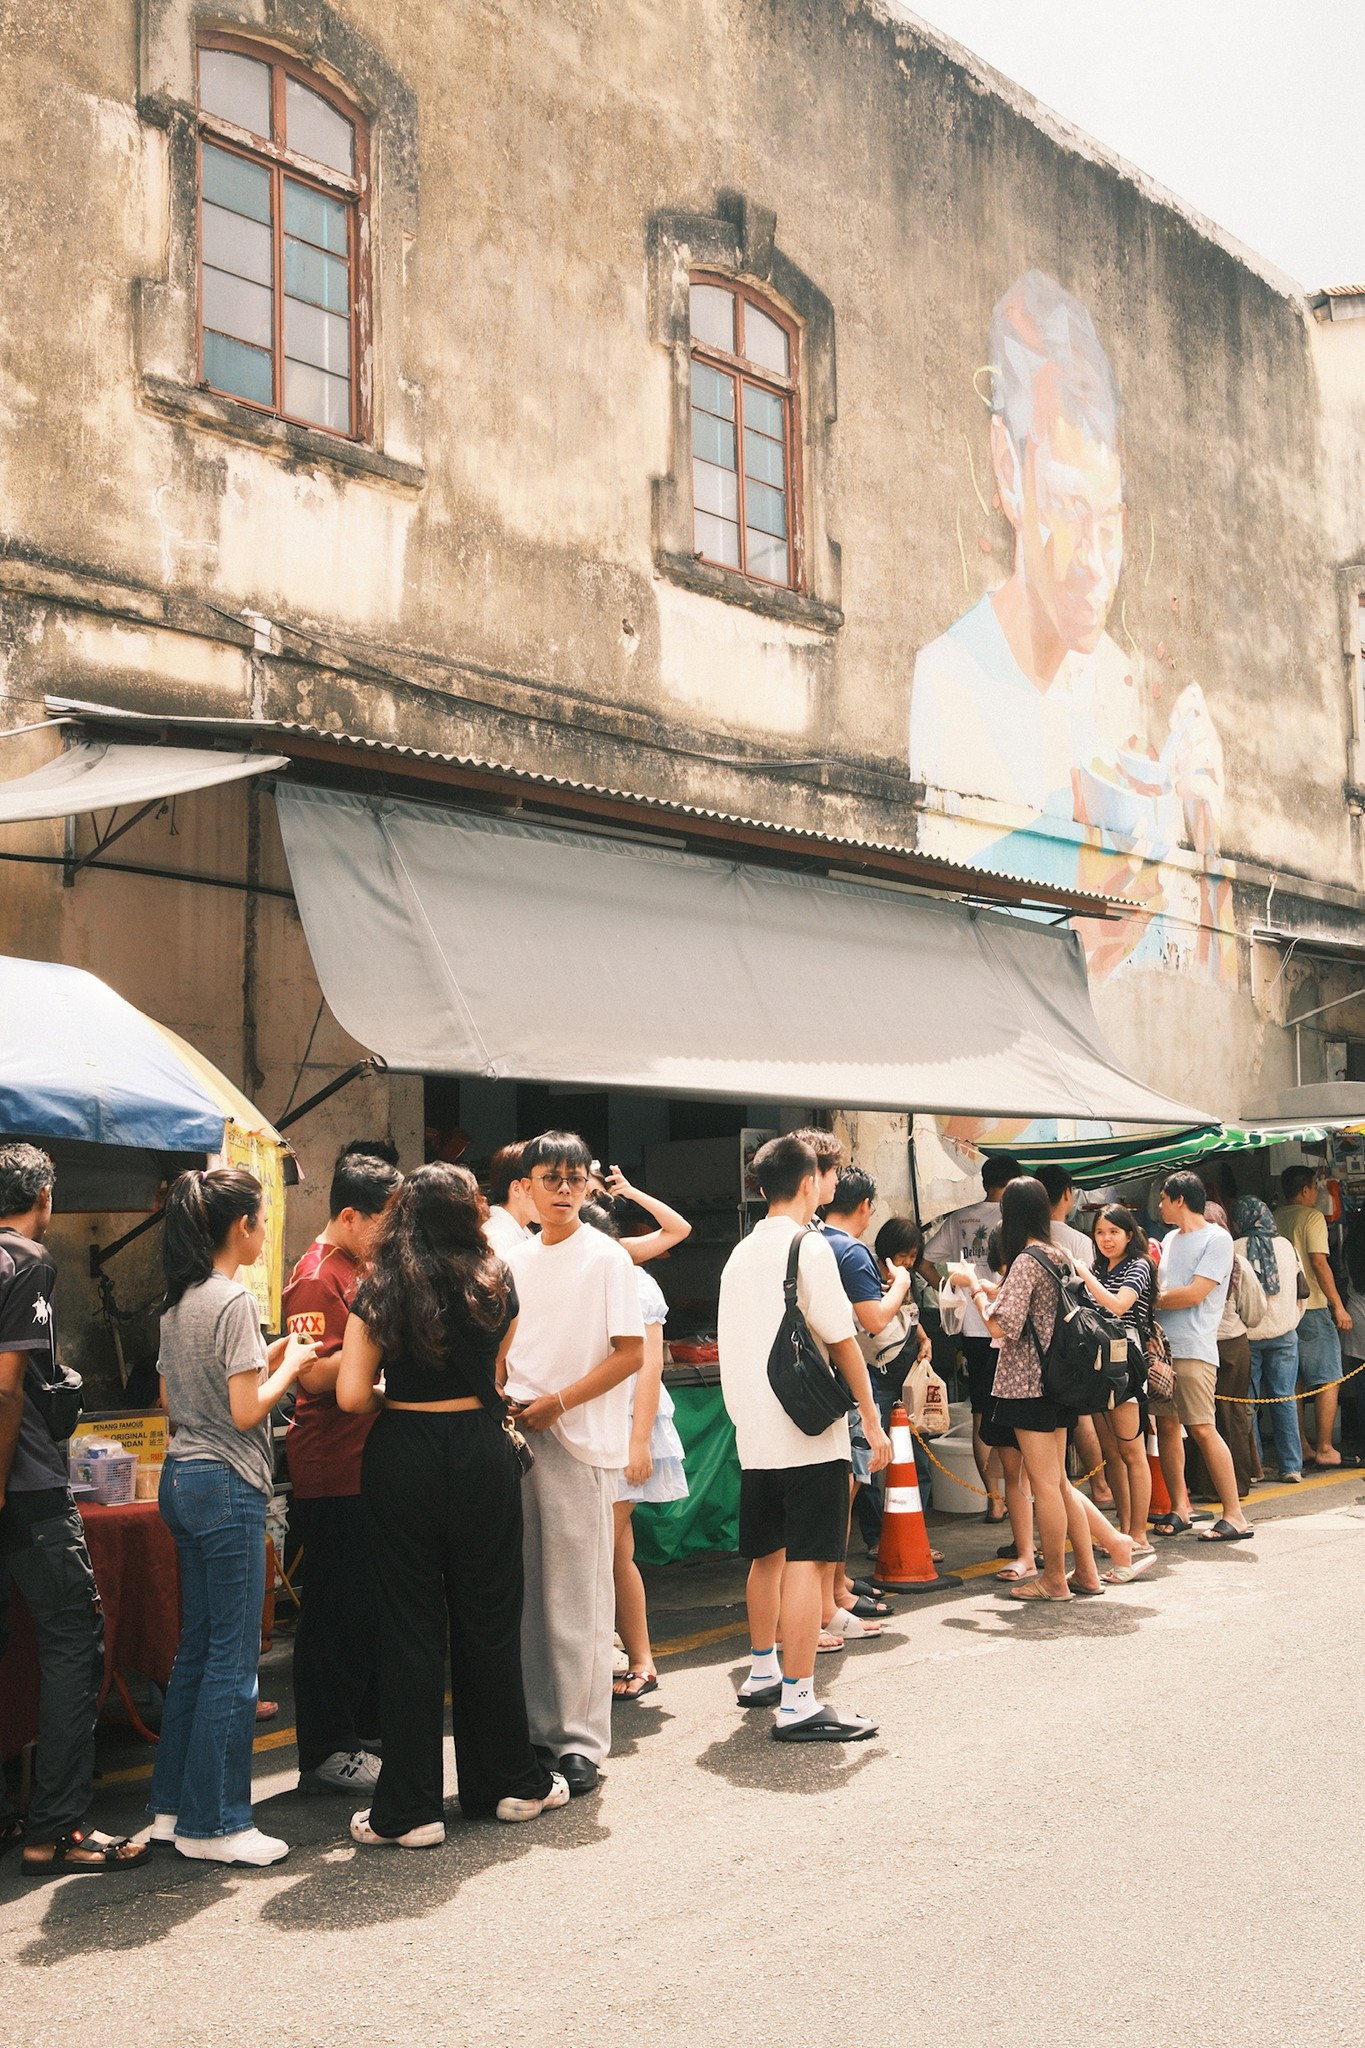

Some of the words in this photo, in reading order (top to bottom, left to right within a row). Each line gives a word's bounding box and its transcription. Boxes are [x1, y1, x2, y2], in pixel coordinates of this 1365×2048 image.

[93, 1422, 118, 1431] PENANG
[119, 1420, 144, 1429] FAMOUS
[110, 1432, 148, 1441] ORIGINAL
[121, 1440, 144, 1448] NDAN
[339, 1764, 358, 1778] N
